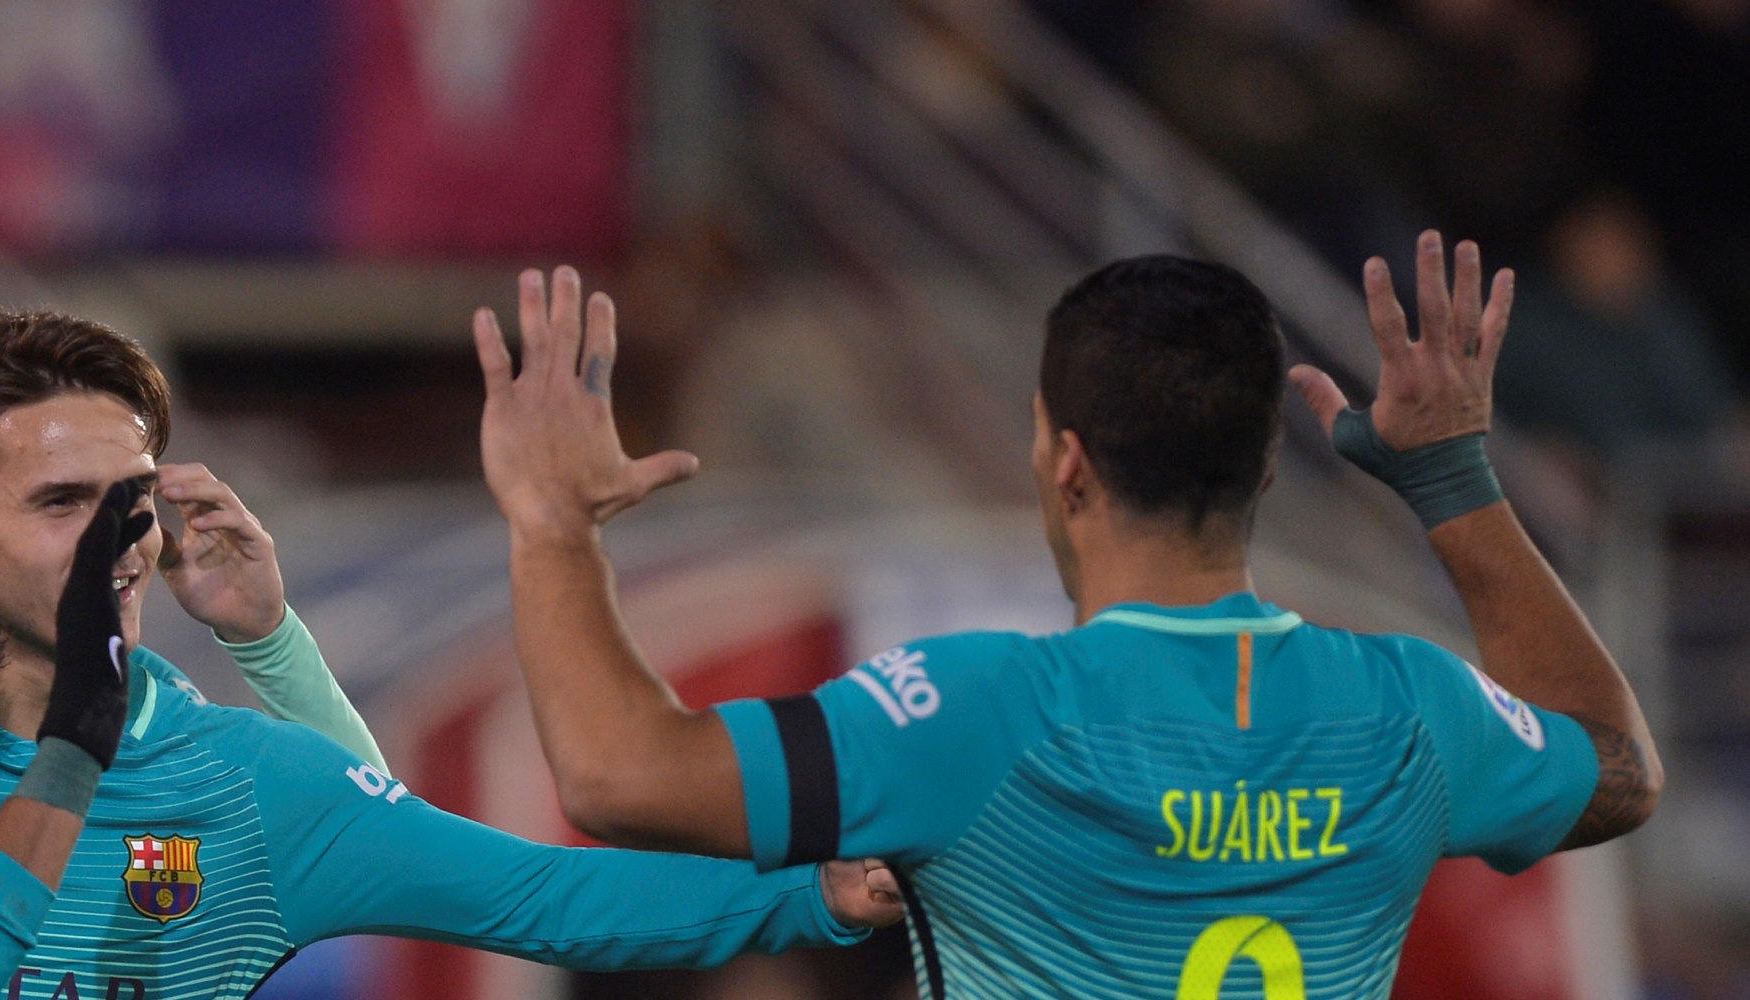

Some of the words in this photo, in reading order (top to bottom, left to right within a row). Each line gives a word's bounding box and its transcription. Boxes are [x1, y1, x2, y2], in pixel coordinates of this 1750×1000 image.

[869, 647, 940, 719] eko
[1156, 779, 1349, 862] SUÁREZ
[149, 871, 179, 882] FCB
